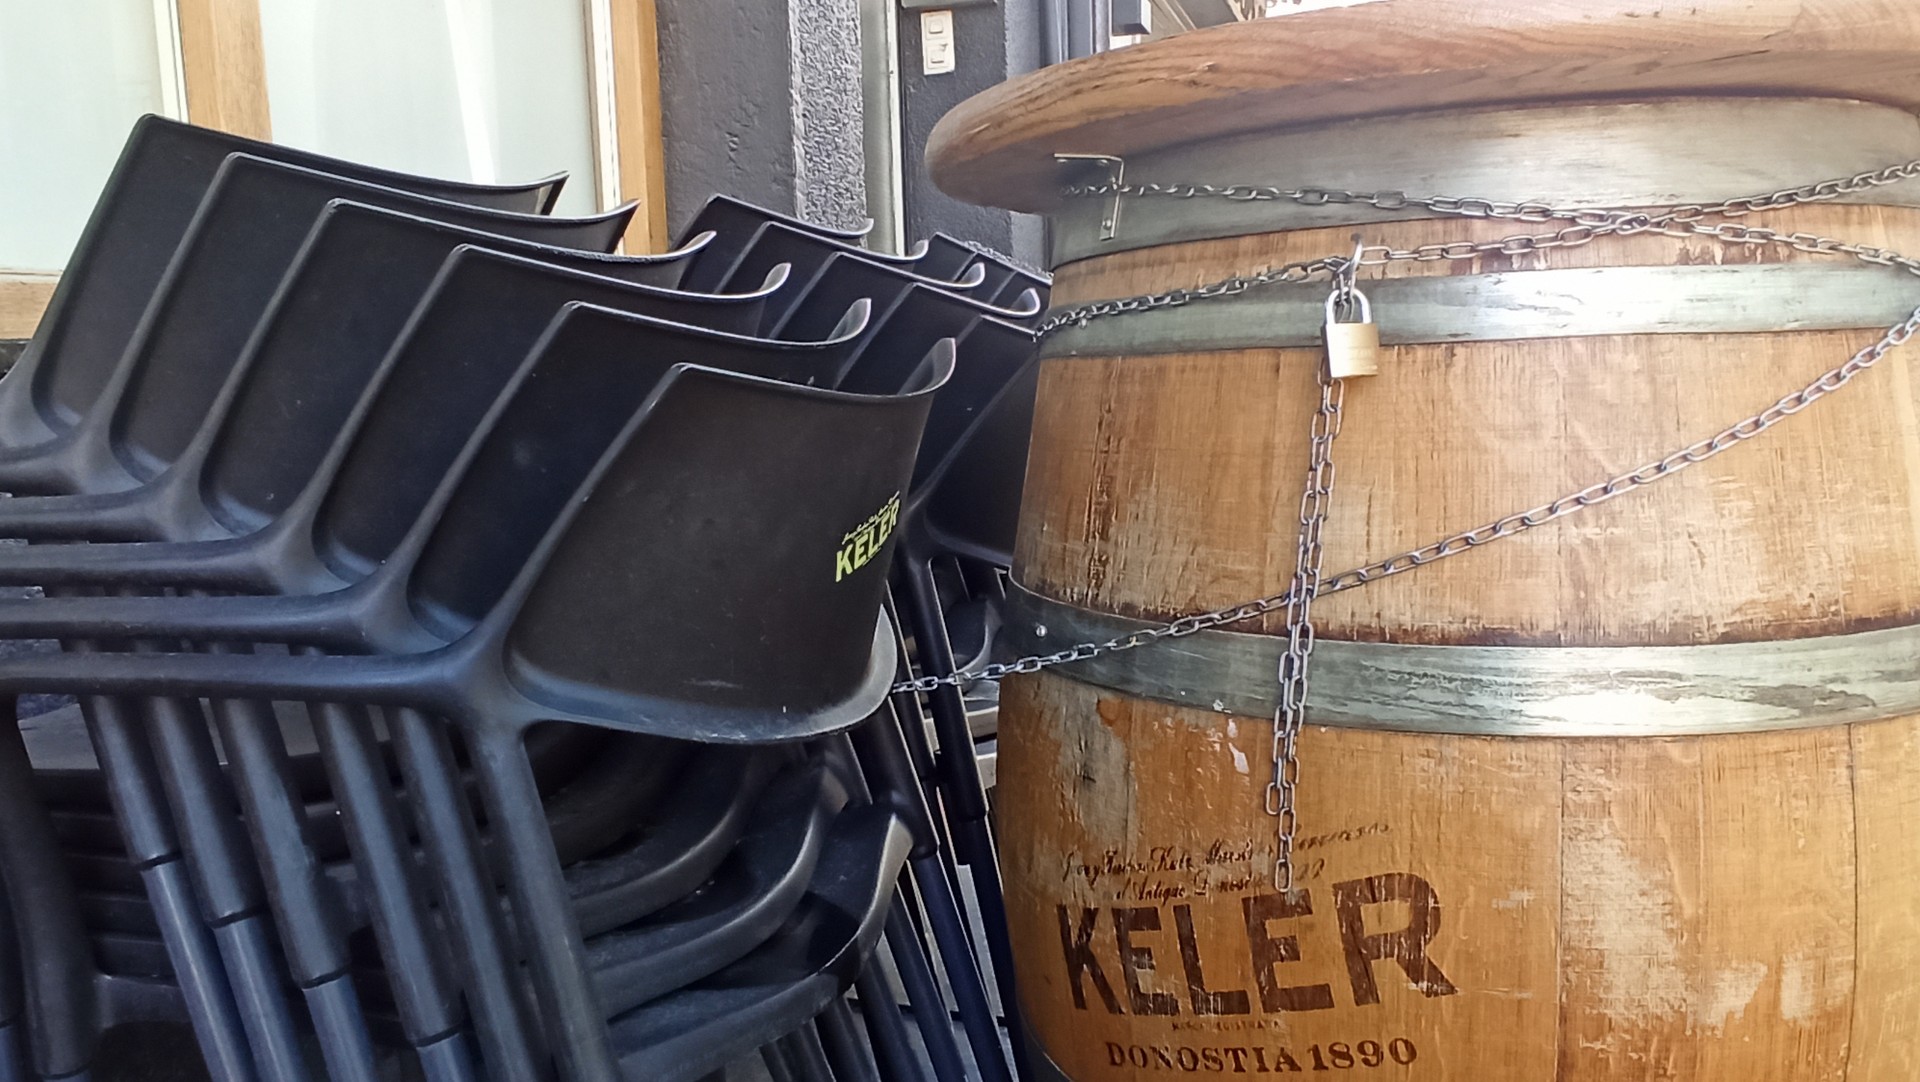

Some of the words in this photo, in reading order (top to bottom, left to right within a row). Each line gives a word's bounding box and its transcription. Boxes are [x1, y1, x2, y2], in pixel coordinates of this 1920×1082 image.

[835, 498, 901, 583] KELER
[1056, 872, 1460, 1016] KELER
[1105, 1040, 1303, 1073] DONOSTIA
[1306, 1037, 1417, 1072] 1890
